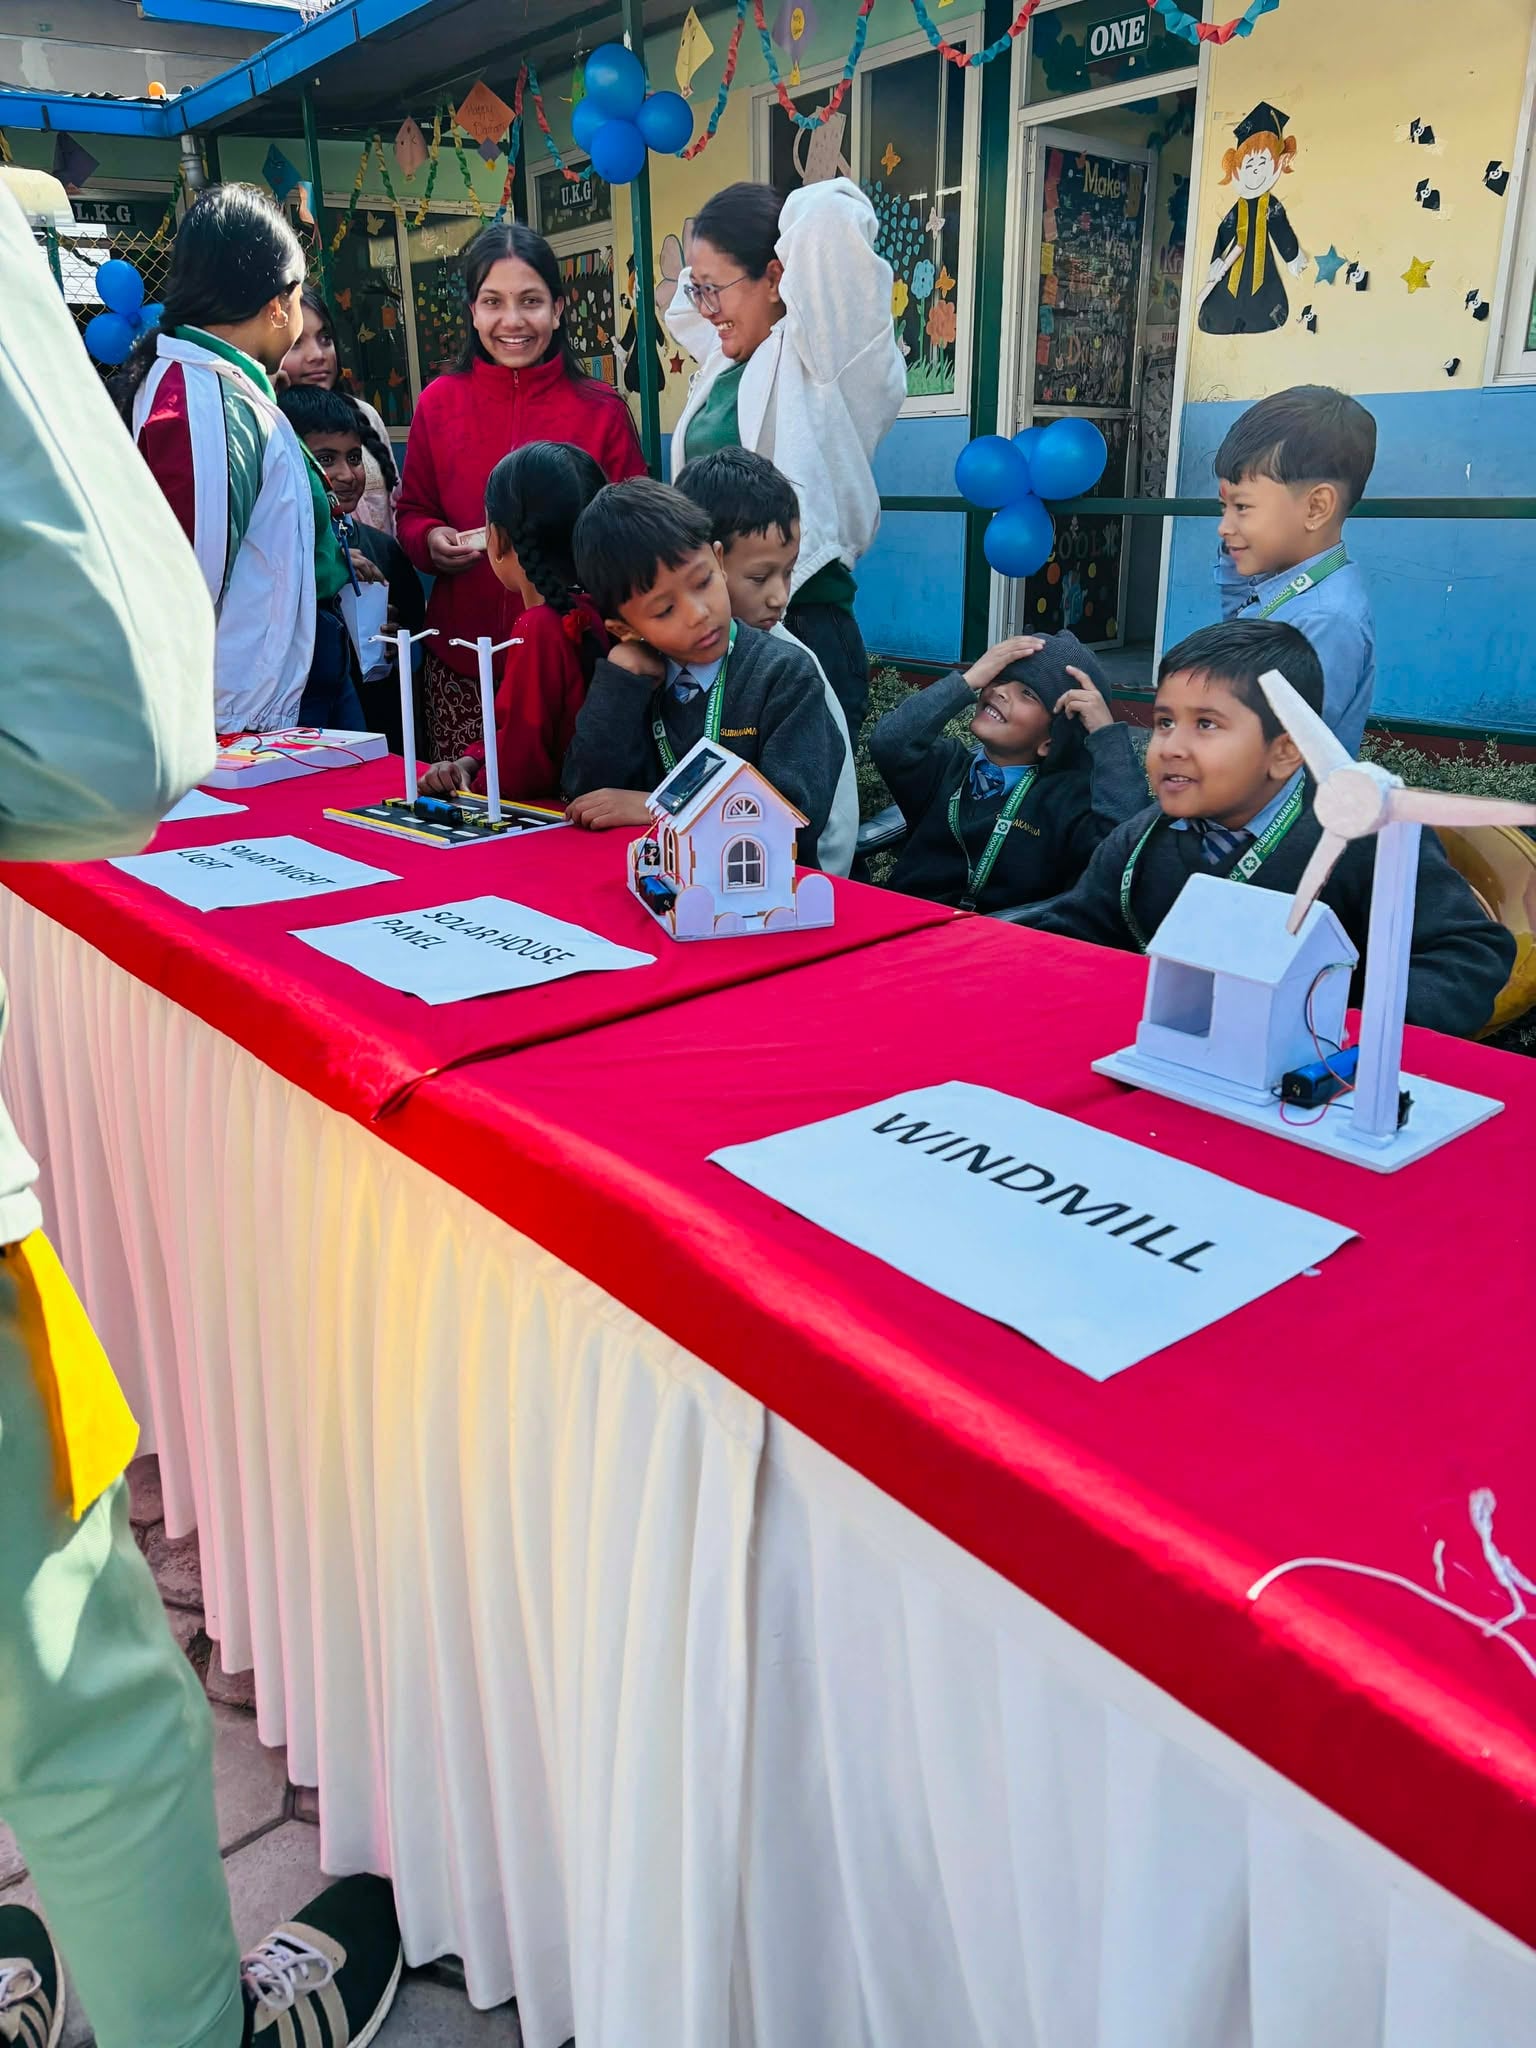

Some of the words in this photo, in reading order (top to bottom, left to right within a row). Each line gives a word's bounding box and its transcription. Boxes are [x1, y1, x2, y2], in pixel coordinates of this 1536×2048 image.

[1090, 15, 1146, 56] ONE
[561, 181, 592, 206] U.K.G
[1083, 160, 1121, 198] Make
[74, 203, 132, 223] L.K.G
[705, 686, 718, 739] UBHAKAMANA
[1253, 798, 1297, 853] SUBHAKAMANA
[176, 849, 234, 870] LIGHT
[220, 844, 287, 867] SMART
[270, 865, 337, 886] NIGHT
[985, 834, 1000, 857] SCHOOL
[371, 919, 447, 950] PANEL
[422, 911, 500, 940] SOLAR
[485, 933, 576, 965] HOUSE
[872, 1112, 1217, 1273] WINDMILL
